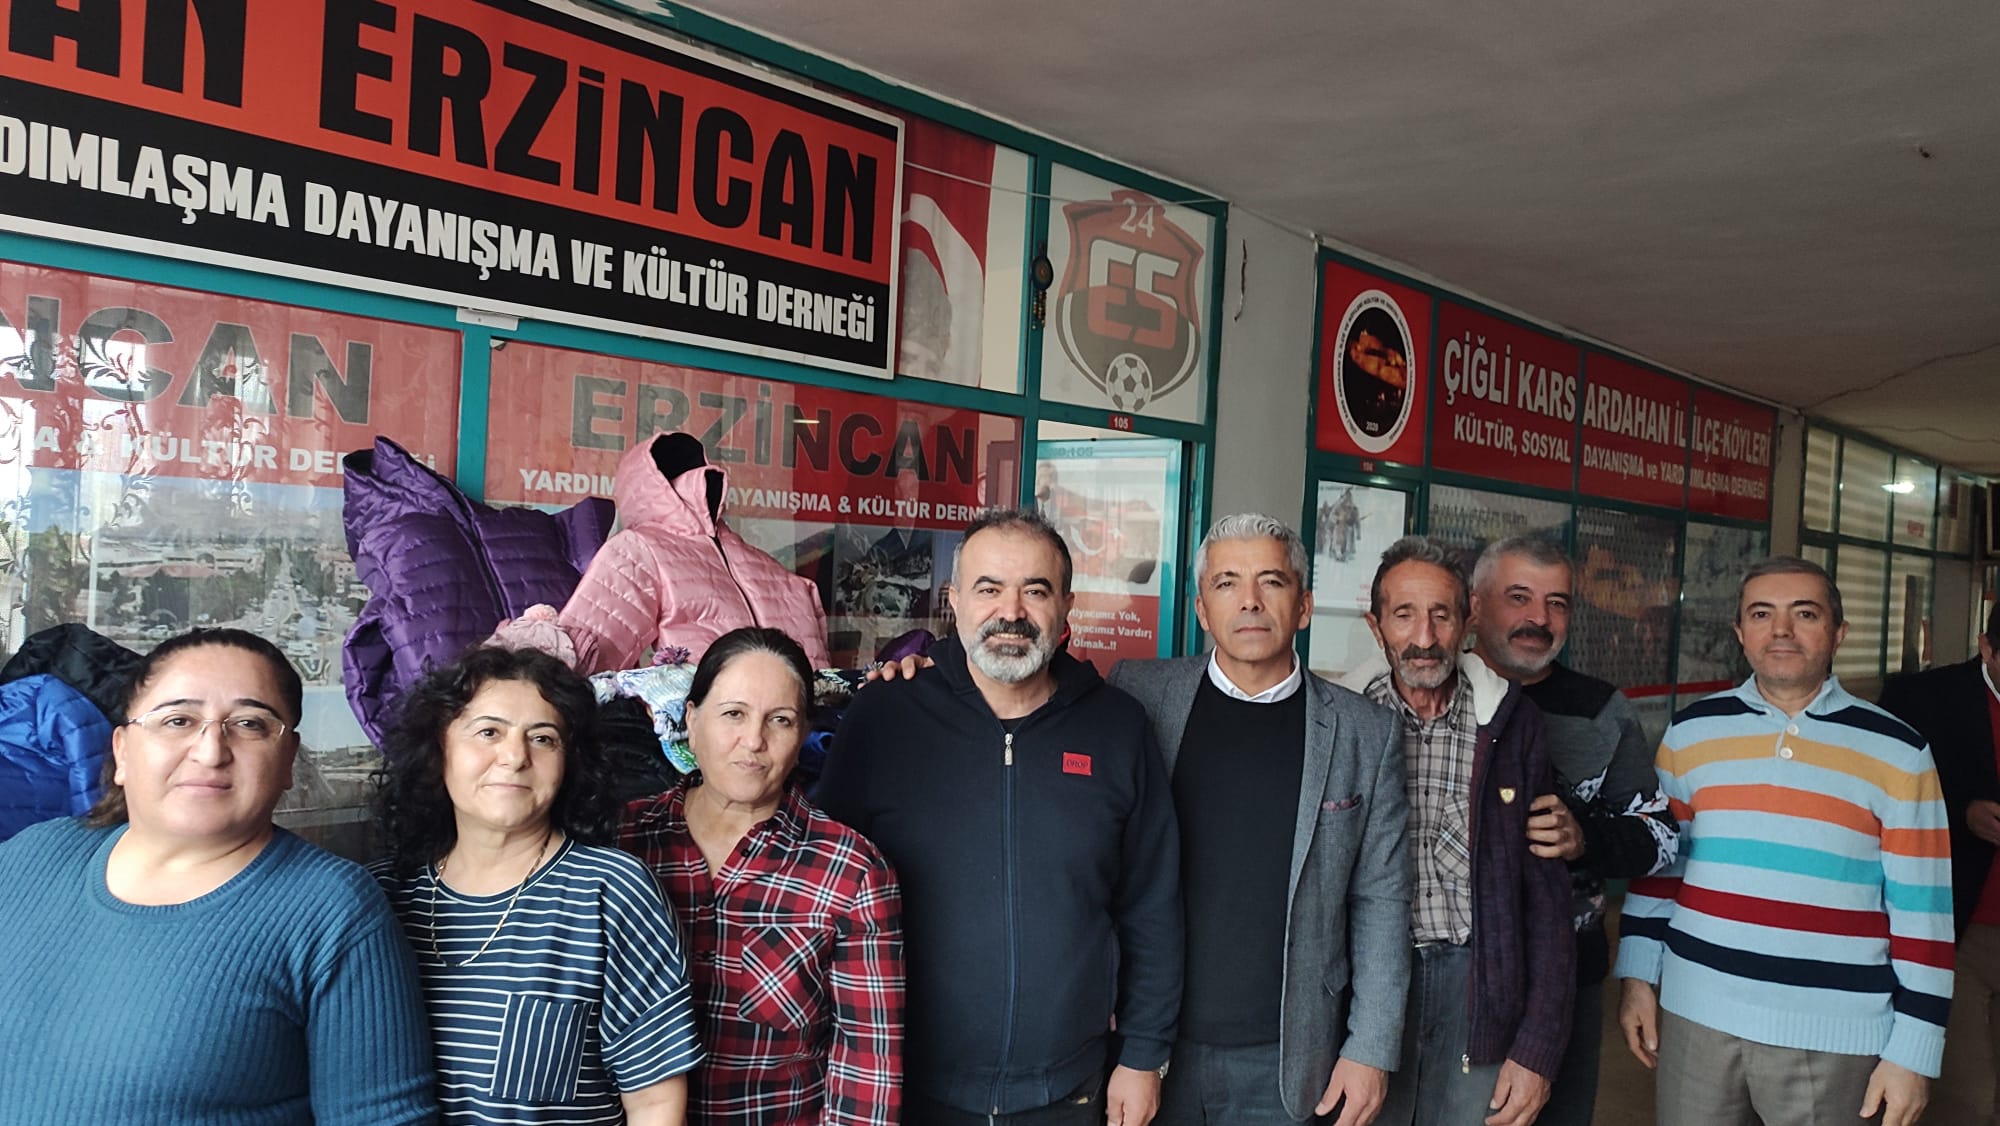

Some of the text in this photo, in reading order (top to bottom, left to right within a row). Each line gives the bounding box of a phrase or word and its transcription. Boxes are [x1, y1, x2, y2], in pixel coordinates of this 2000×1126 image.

[319, 0, 877, 264] ERZİNCAN
[304, 181, 559, 281] DAYANIŞMA
[570, 238, 613, 290] VE
[622, 245, 748, 317] KÜLTÜR
[757, 280, 874, 343] DERNEĞİ
[1120, 197, 1155, 238] 24
[571, 374, 976, 485] ERZİNCAN
[1114, 416, 1129, 429] 105
[1444, 331, 1511, 405] ÇİĞLİ
[1517, 361, 1577, 422] KARS
[1583, 383, 1671, 445] ARDAHAN
[1674, 400, 1687, 447] İL
[1454, 412, 1517, 457] KÜLTÜR,
[1521, 430, 1571, 463] SOSYAL
[1584, 444, 1645, 480] DAYANIŞMA
[1647, 463, 1658, 480] ve
[726, 487, 832, 513] AYANIŞMA
[837, 495, 851, 514] &
[858, 494, 930, 519] KÜLTÜR
